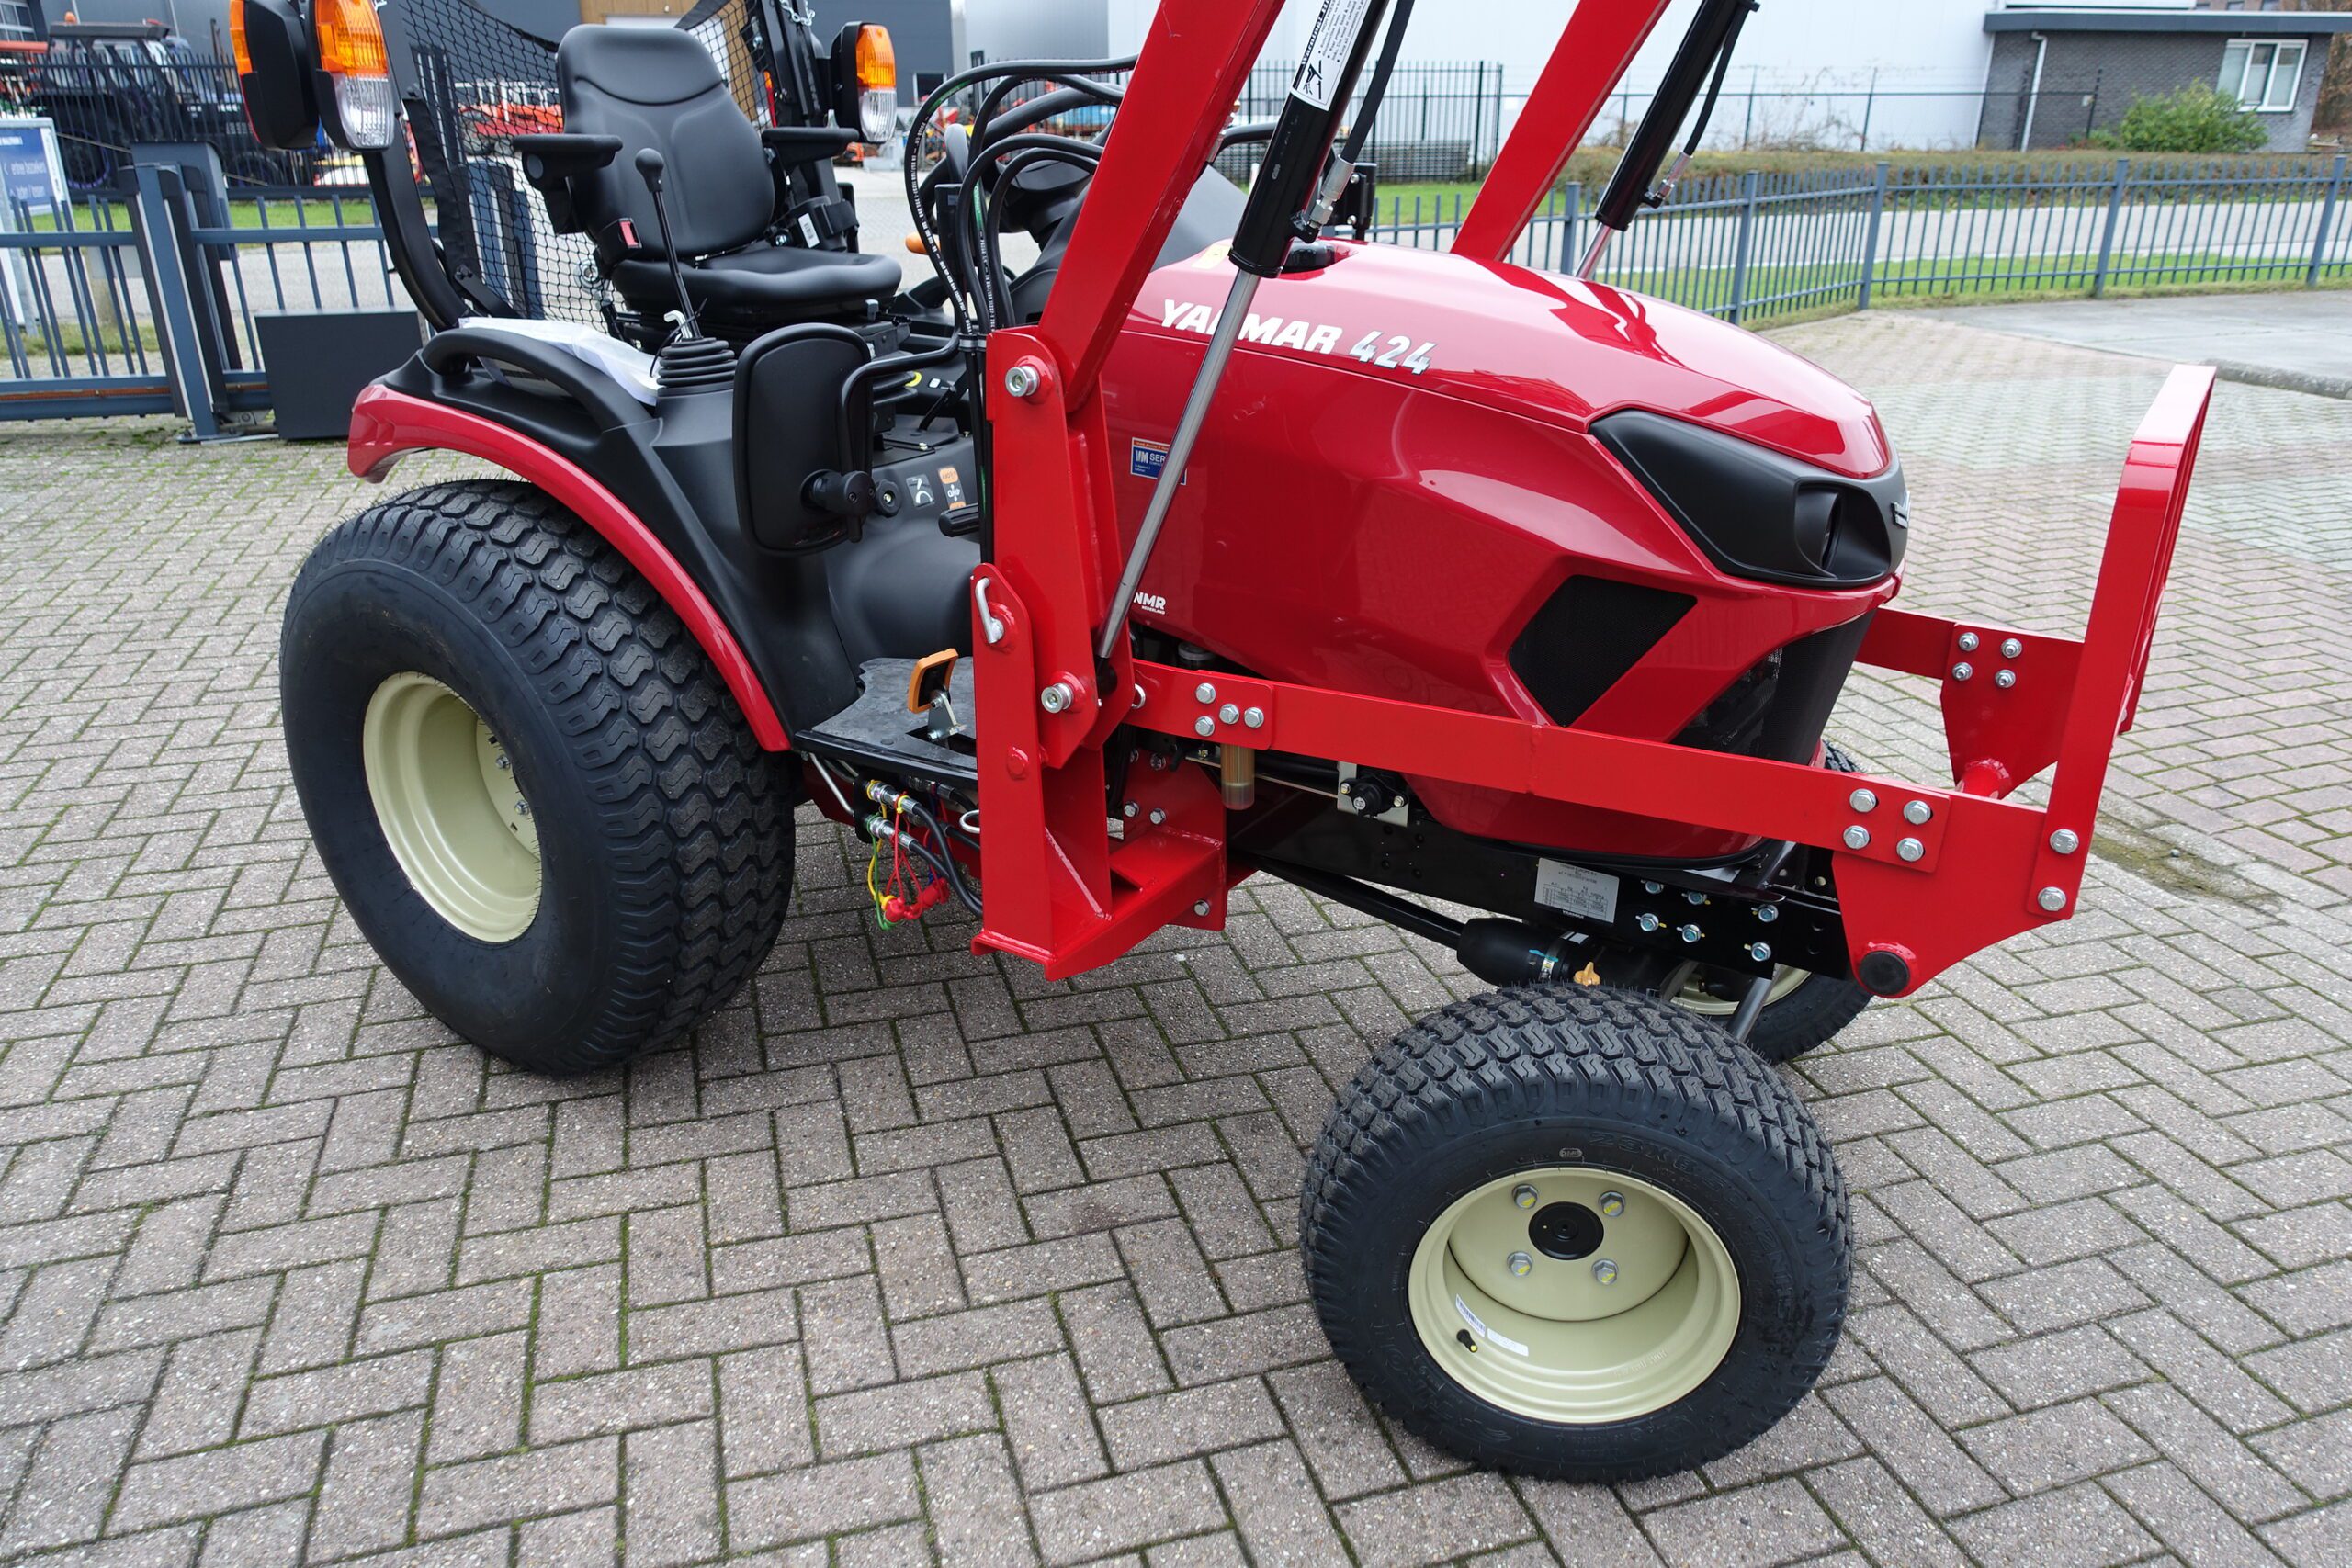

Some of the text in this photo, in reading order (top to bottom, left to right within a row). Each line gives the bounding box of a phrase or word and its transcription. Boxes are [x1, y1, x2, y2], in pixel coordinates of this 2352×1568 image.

[1301, 17, 1322, 65] Warning!
[1161, 299, 1437, 376] YAMAR 424
